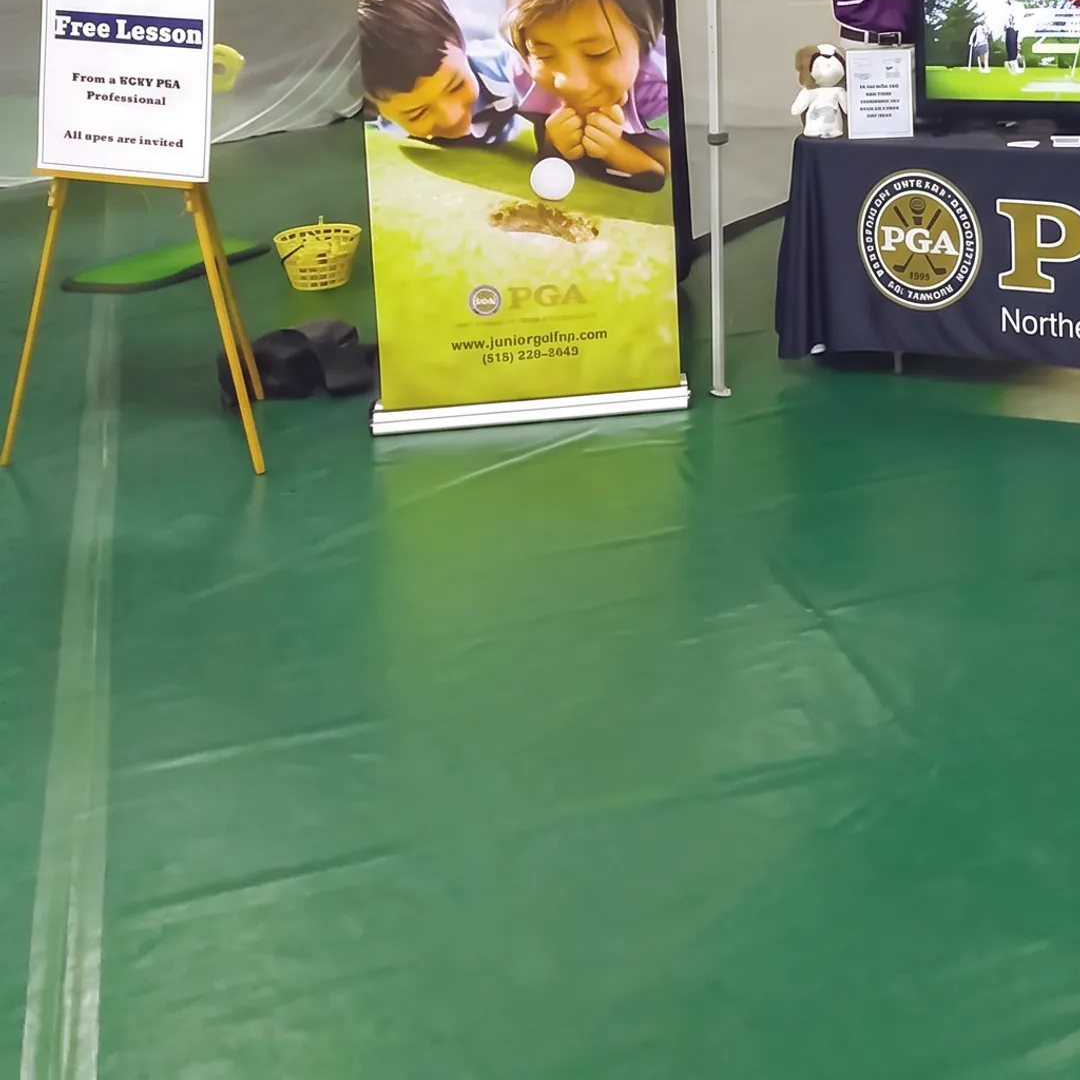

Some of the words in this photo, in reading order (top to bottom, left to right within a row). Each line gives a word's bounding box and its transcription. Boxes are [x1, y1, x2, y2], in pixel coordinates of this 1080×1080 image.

[55, 15, 110, 39] Free
[115, 18, 203, 46] Lesson
[72, 72, 106, 84] From
[109, 77, 116, 85] a
[86, 90, 167, 106] Professional
[63, 129, 83, 140] All
[117, 135, 137, 145] are
[139, 135, 184, 148] invited
[880, 225, 959, 256] PGA
[508, 282, 588, 310] PGA
